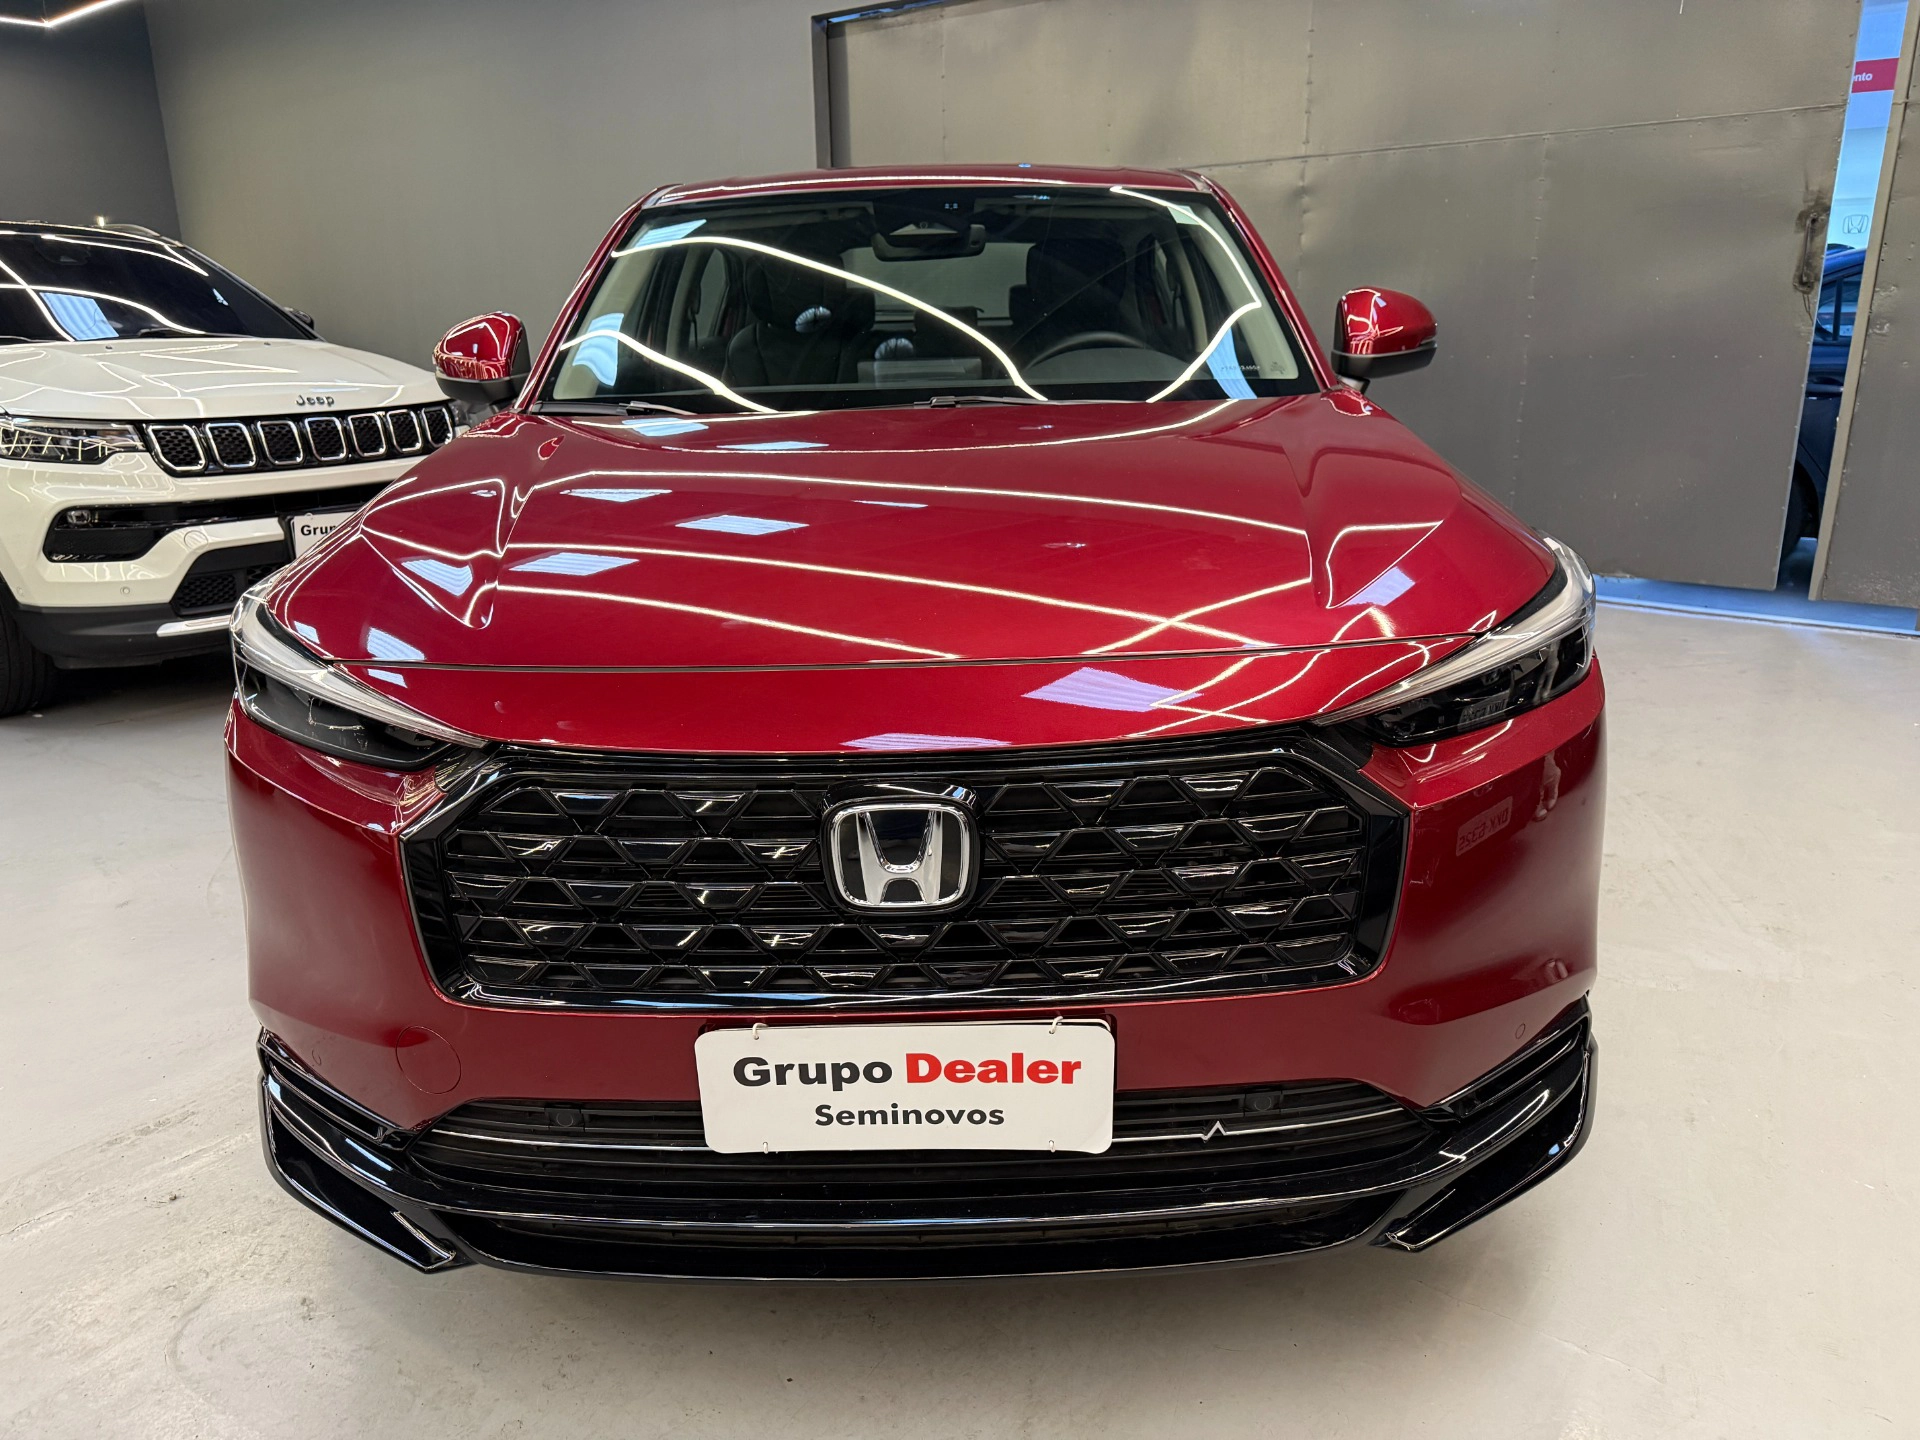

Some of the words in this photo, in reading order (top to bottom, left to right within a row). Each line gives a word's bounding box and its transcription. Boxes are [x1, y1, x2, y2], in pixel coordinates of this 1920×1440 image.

[1853, 72, 1873, 82] nto
[296, 394, 335, 407] Jeep
[733, 1057, 892, 1091] Grupo
[905, 1053, 1082, 1084] Dealer
[815, 1103, 1005, 1126] Seminovos
